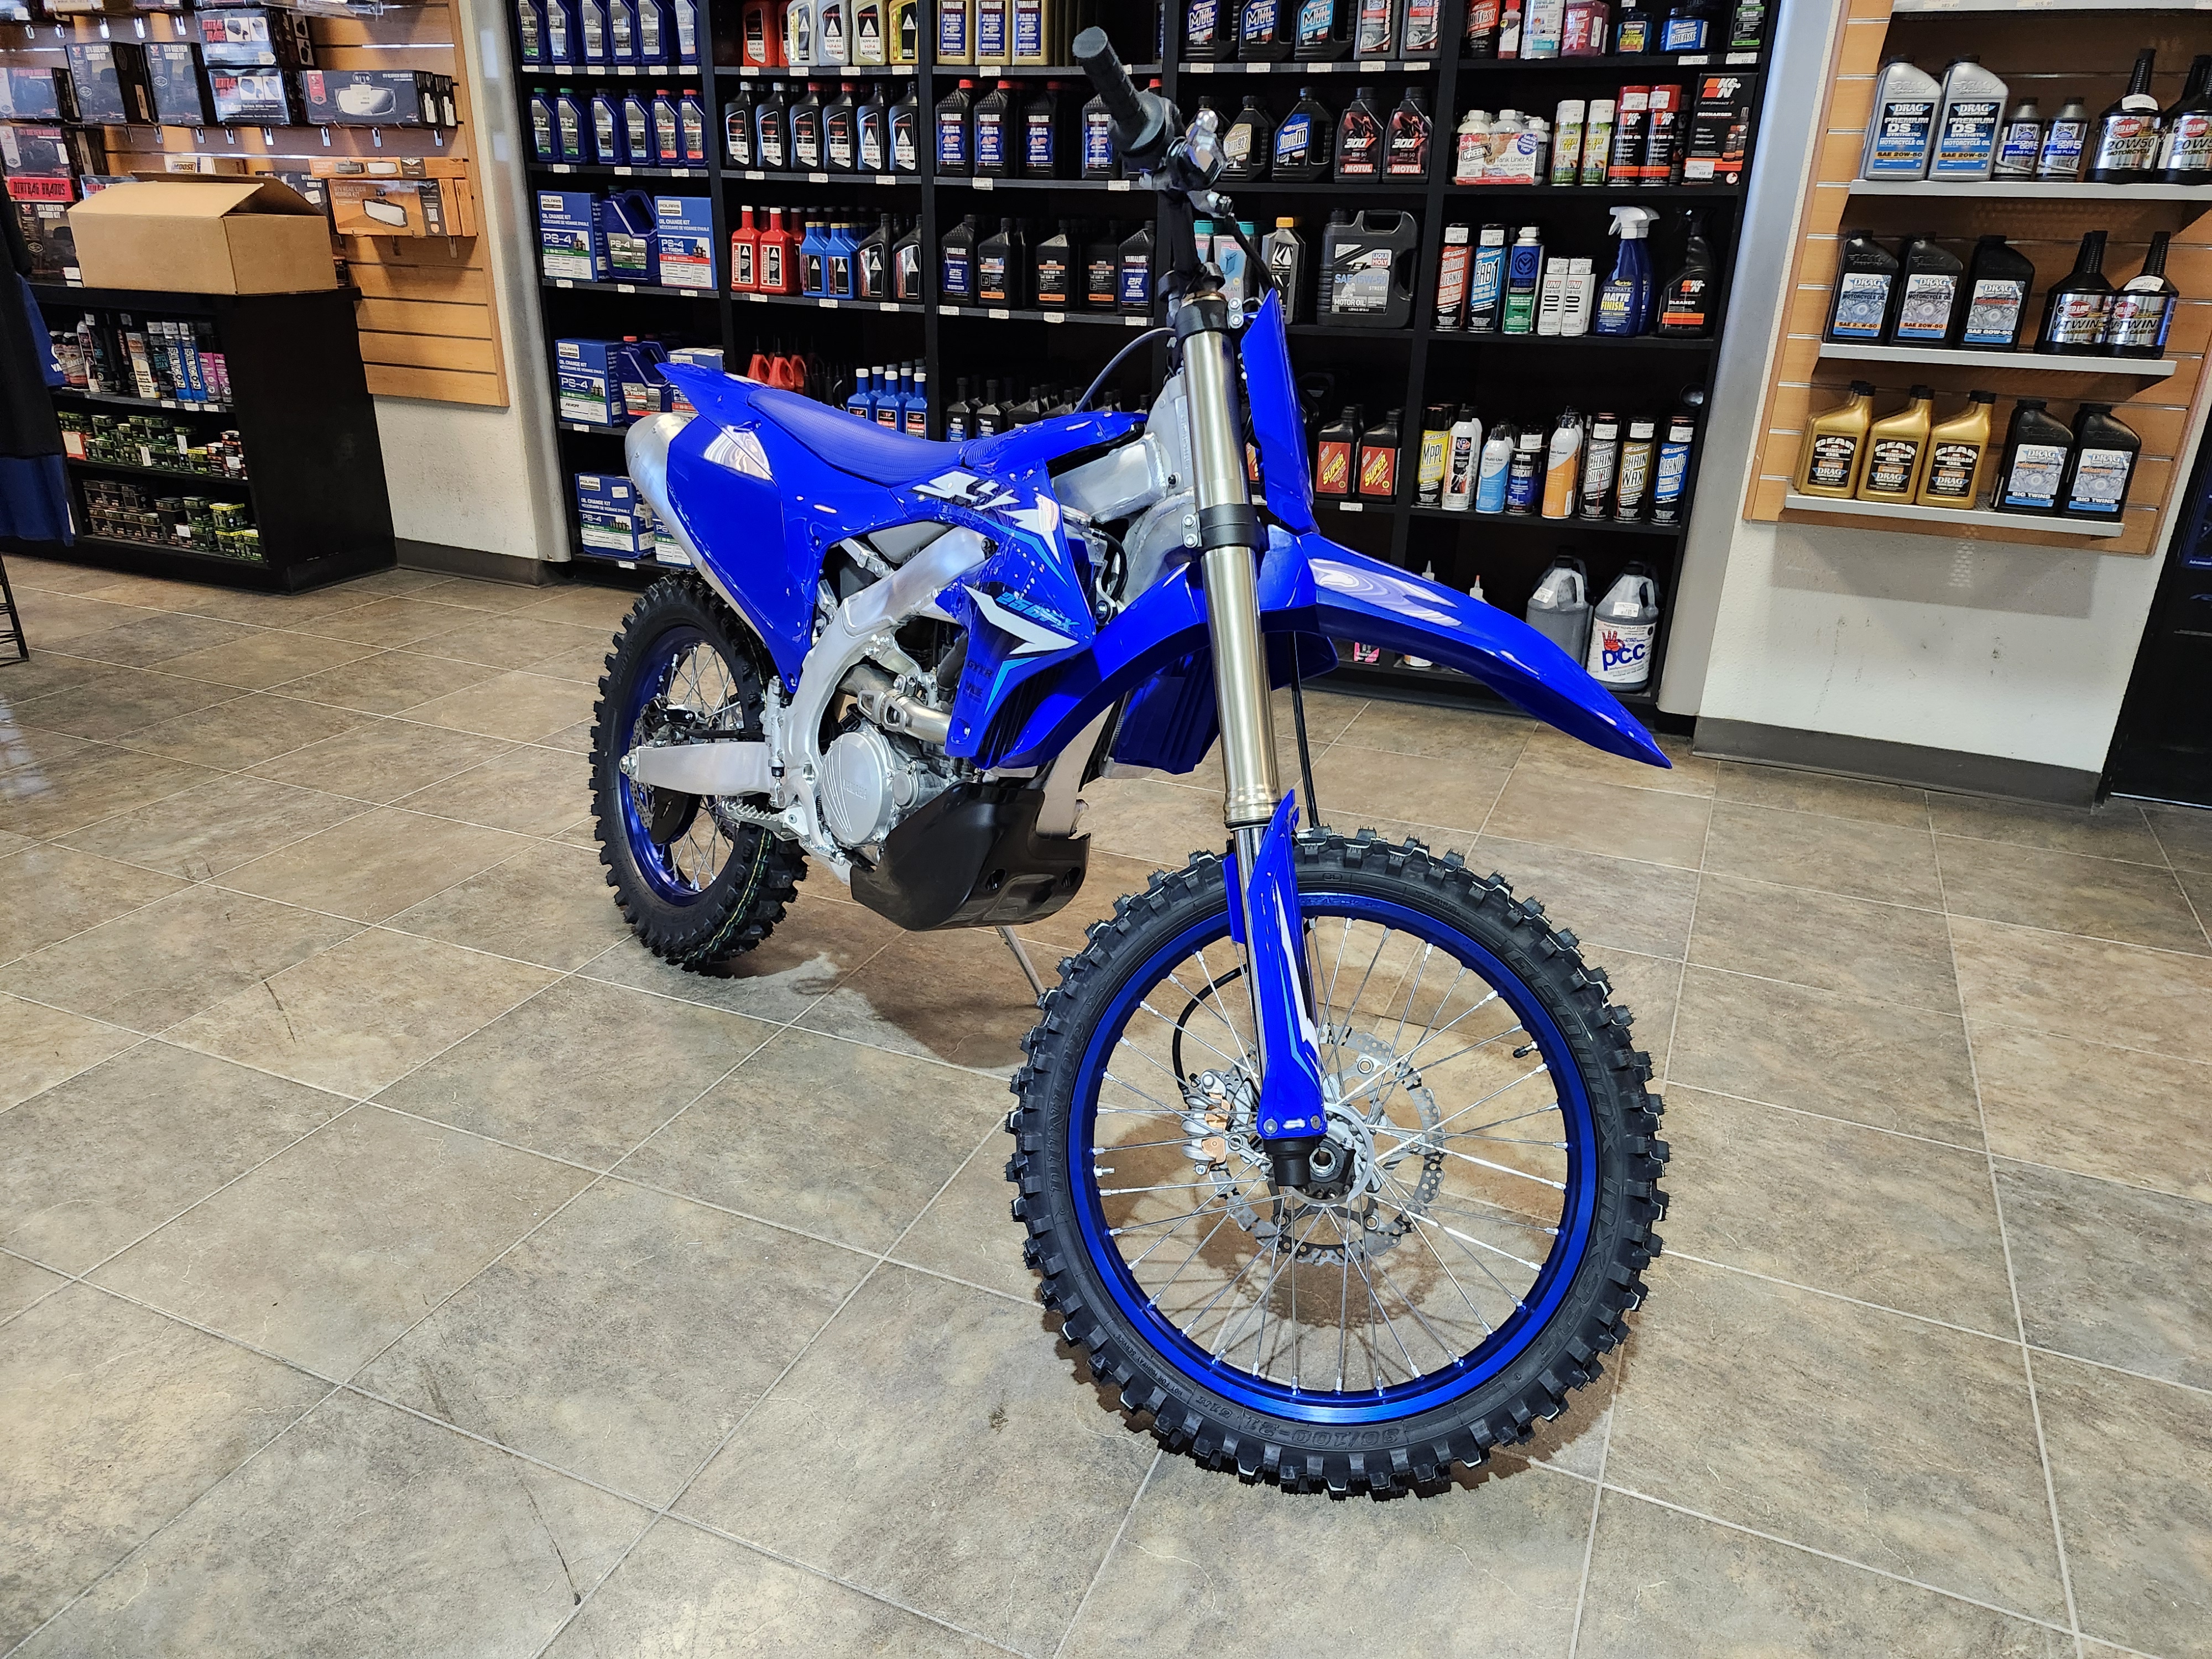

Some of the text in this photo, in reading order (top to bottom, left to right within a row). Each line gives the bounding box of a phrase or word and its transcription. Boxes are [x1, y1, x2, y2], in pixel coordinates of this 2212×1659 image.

[1670, 32, 1696, 44] GREASE
[1719, 77, 1741, 98] K&N
[1895, 104, 1924, 112] DRAG
[1959, 104, 1990, 112] DRAG
[1238, 135, 1249, 150] 927
[1344, 137, 1377, 149] 300V
[1392, 138, 1426, 149] 300V
[2107, 138, 2154, 150] 20W50
[544, 233, 571, 244] PS-4
[661, 239, 684, 248] PS-4
[1128, 278, 1141, 286] 2R
[1335, 274, 1387, 284] SAE 15W-50
[1439, 270, 1463, 288] CLEANER
[1854, 278, 1881, 286] DRAG
[1691, 280, 1705, 293] K&N
[1602, 293, 1630, 301] MATTE
[1542, 295, 1559, 315] OIL
[1564, 296, 1580, 316] OIL
[1600, 301, 1625, 310] FINISH
[2053, 321, 2100, 330] V-TWIN
[2111, 320, 2158, 329] V-TWIN
[561, 377, 588, 389] PS-4
[1815, 437, 1855, 451] GEAR
[1875, 442, 1916, 456] GEAR
[1422, 443, 1443, 466] MPPL
[1936, 446, 1978, 460] GEAR
[1589, 451, 1614, 469] CHAIN
[1623, 452, 1648, 469] CHAIN
[1323, 453, 1345, 485] SUPER
[1365, 454, 1386, 487] SUPER
[1587, 466, 1611, 483] GUARD
[1817, 467, 1842, 475] DRAG
[1621, 468, 1646, 488] WAX
[1877, 472, 1902, 481] DRAG
[583, 514, 601, 522] PS-4
[1602, 644, 1645, 671] pcc
[1504, 948, 1620, 1160] GEOMAX
[1047, 1019, 1084, 1194] DUNLOP
[1138, 1356, 1158, 1376] HIGHWAY
[1159, 1374, 1170, 1387] FOR
[1171, 1385, 1183, 1396] NOT
